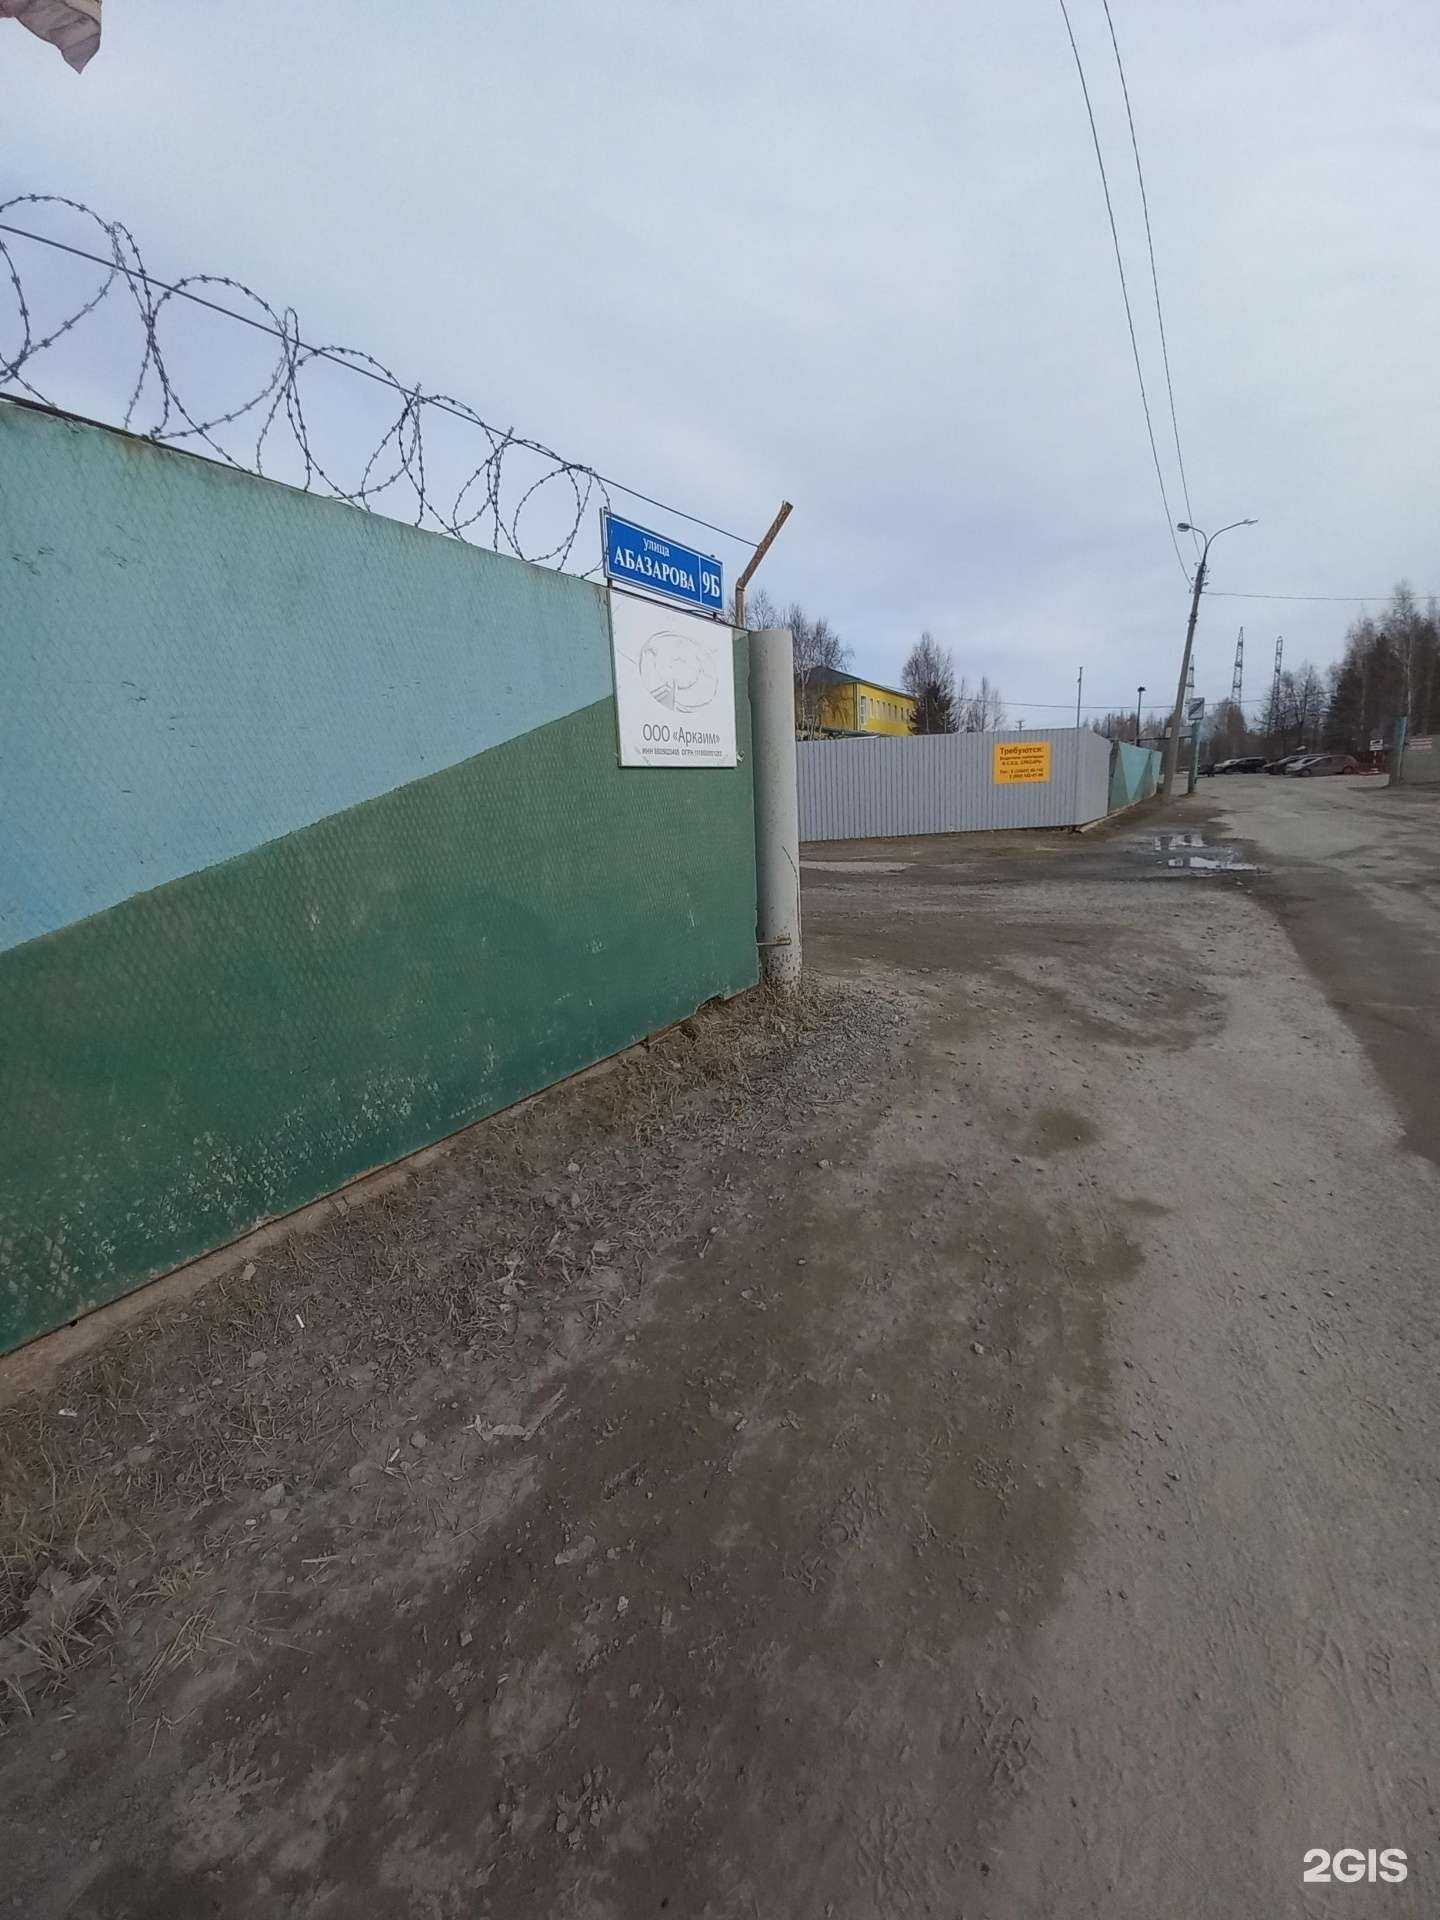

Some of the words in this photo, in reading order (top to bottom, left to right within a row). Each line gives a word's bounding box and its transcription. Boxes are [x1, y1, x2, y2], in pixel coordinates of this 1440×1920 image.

[642, 537, 670, 557] улица
[614, 545, 696, 592] АБАЗАРОВА
[702, 571, 721, 598] 9Б
[642, 723, 671, 742] ООО
[672, 726, 721, 747] «Аркаим»
